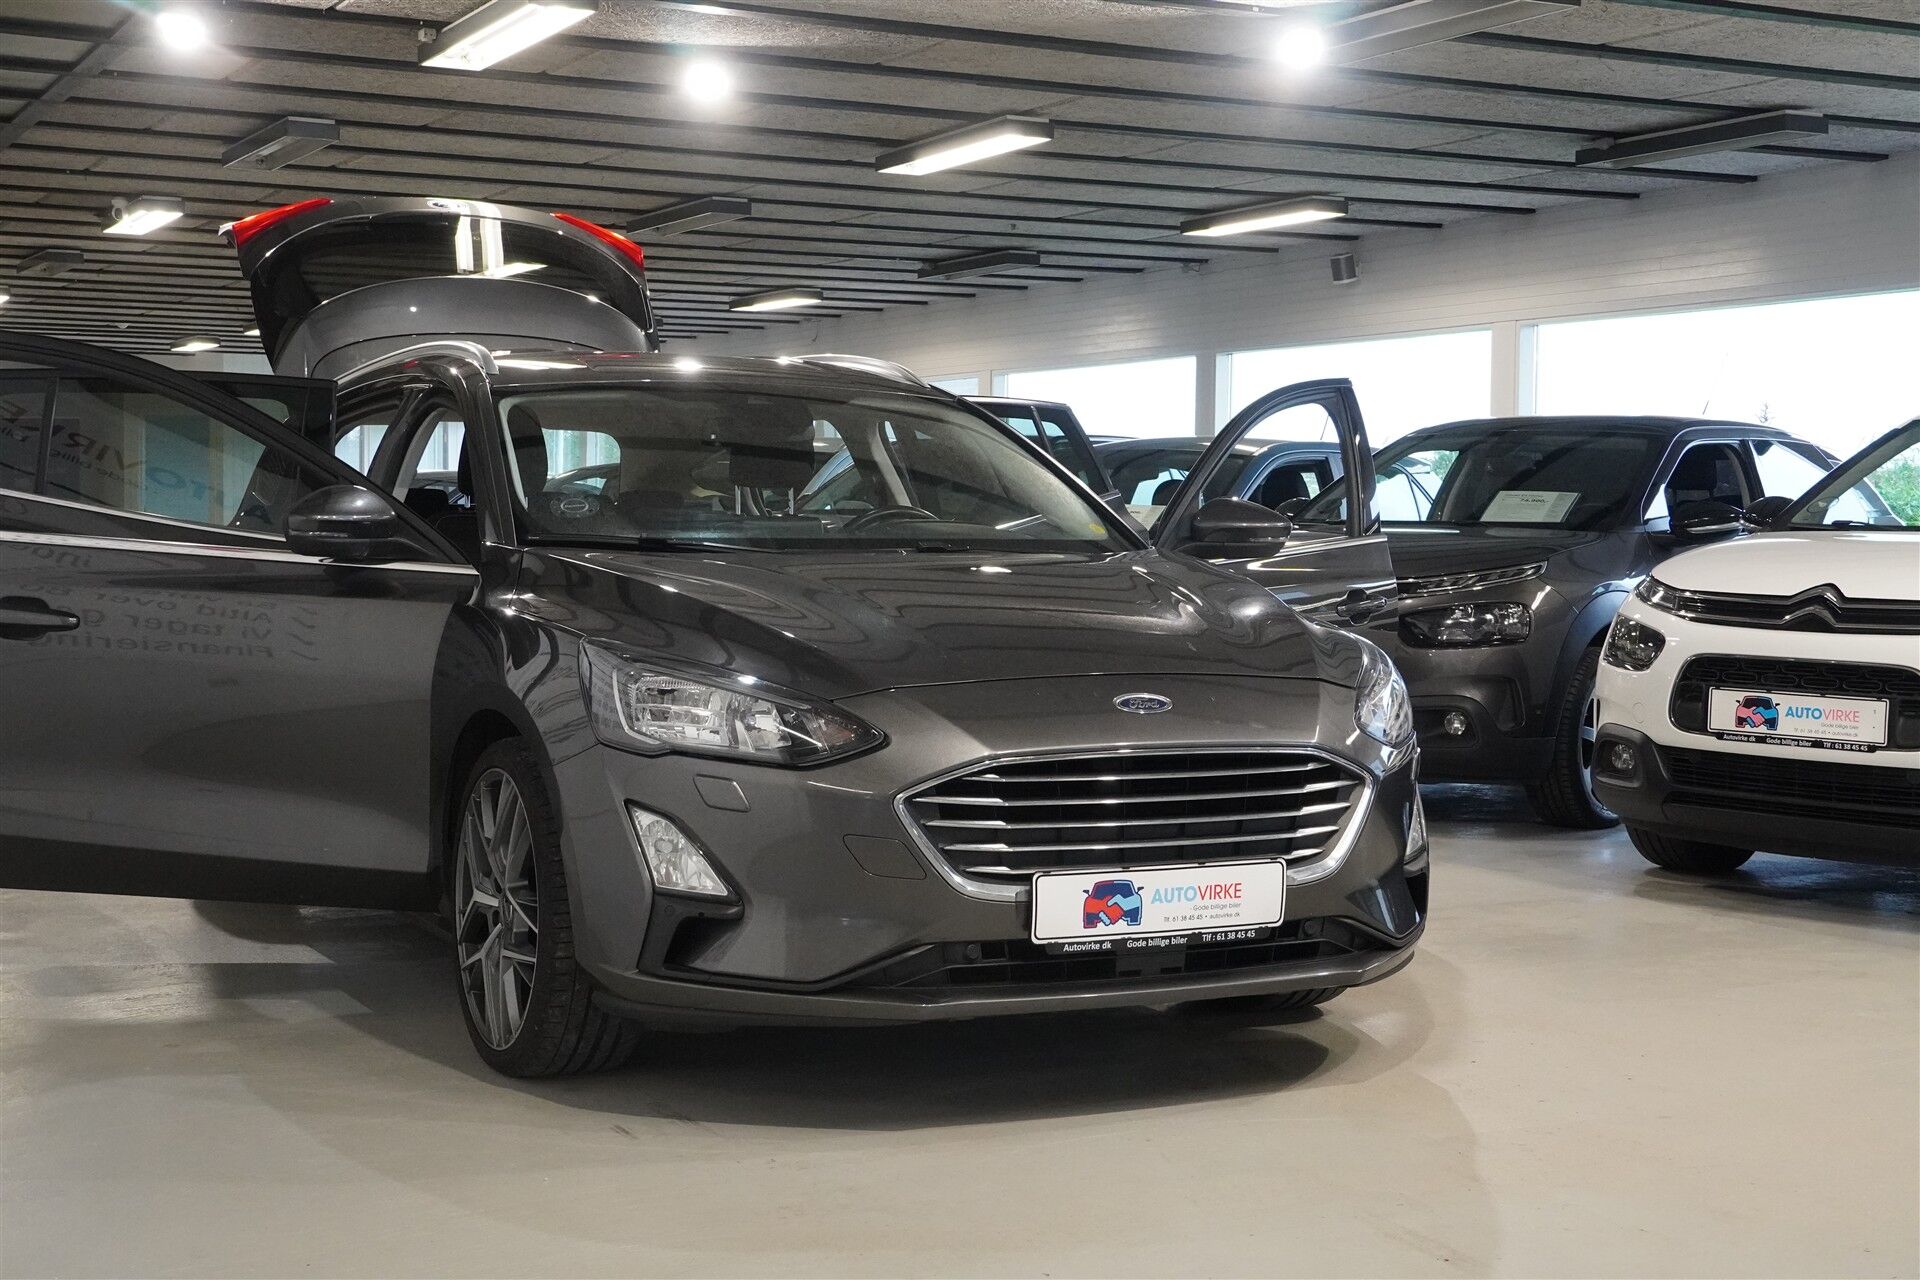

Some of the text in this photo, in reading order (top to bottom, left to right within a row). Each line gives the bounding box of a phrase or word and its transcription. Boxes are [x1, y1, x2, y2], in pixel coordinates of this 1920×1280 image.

[1128, 697, 1160, 709] Ford
[1785, 706, 1860, 723] AUTOVIRKE
[1723, 734, 1748, 742] Autovirke
[1151, 882, 1242, 904] AUTOVIRKE
[1210, 903, 1228, 911] billige
[1063, 942, 1100, 952] Autovirke
[1102, 941, 1112, 949] dk
[1126, 939, 1147, 948] Gode
[1148, 937, 1170, 947] billige
[1171, 936, 1188, 945] biler
[1216, 932, 1225, 940] 61
[1227, 931, 1235, 940] 38
[1236, 930, 1245, 939] 45
[1246, 929, 1256, 938] 45
